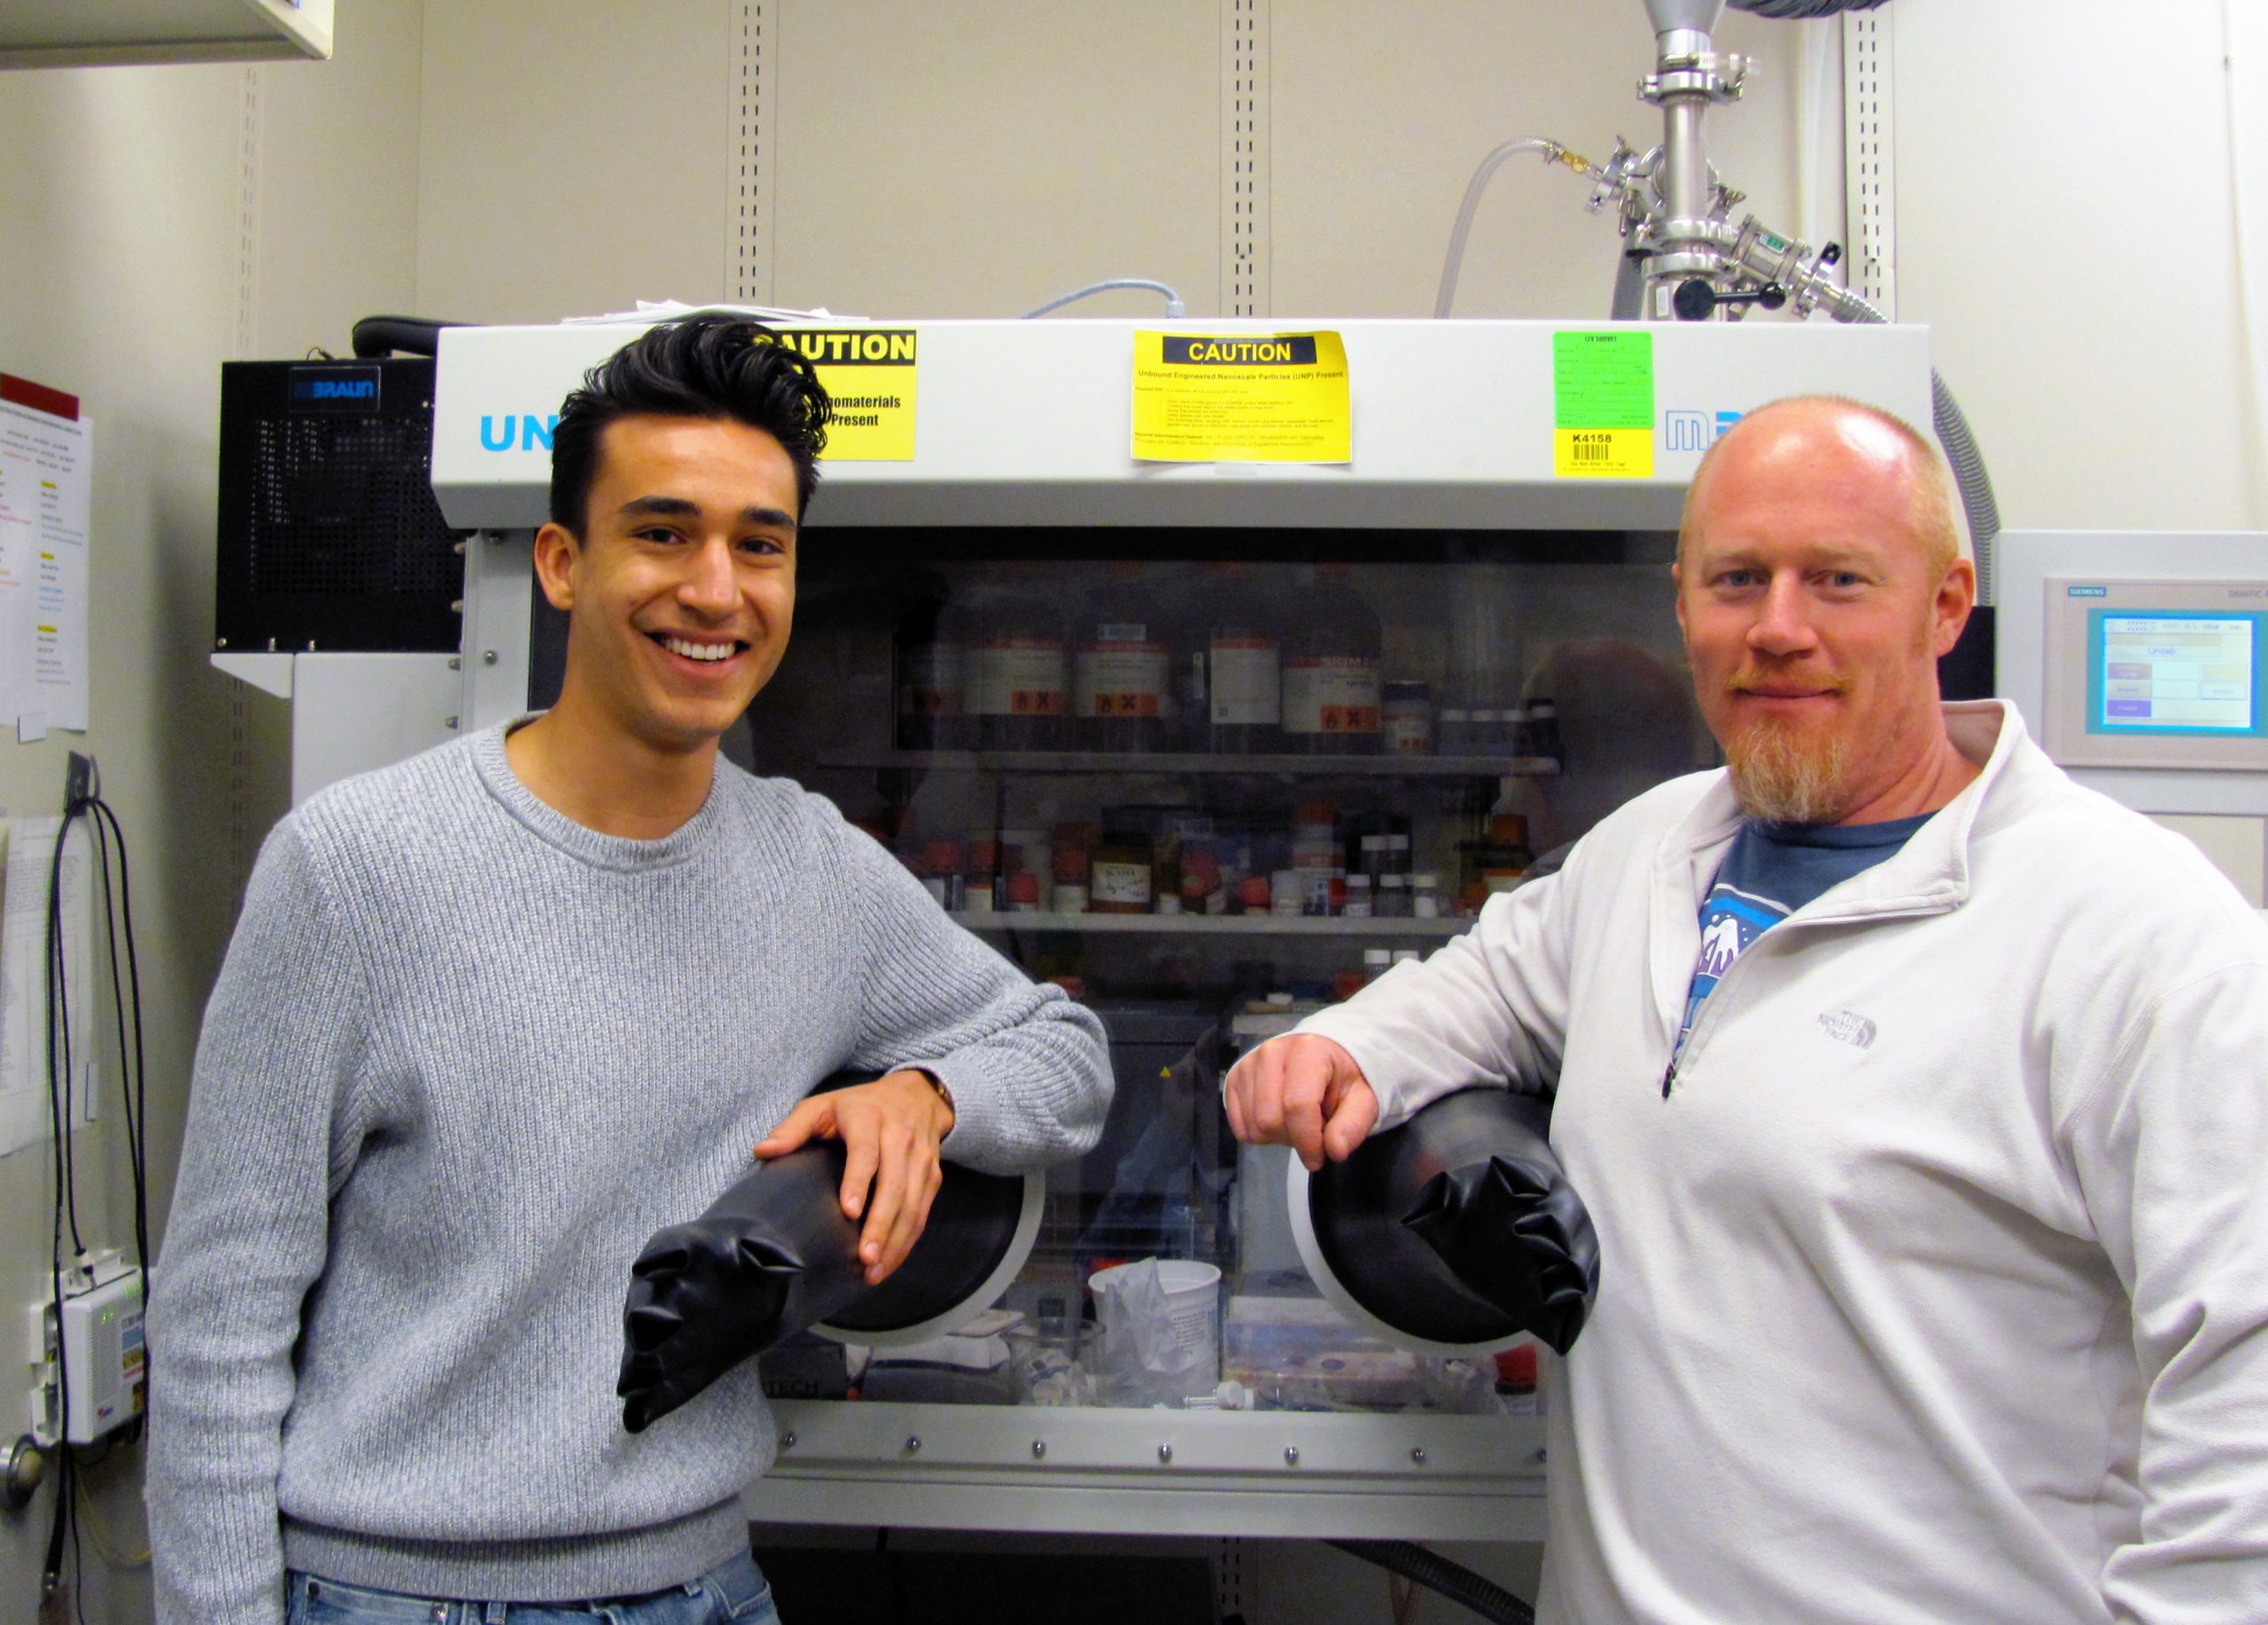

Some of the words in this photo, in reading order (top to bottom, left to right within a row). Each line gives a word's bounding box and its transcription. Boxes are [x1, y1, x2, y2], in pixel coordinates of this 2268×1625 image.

[753, 333, 915, 361] AUTION
[1188, 342, 1292, 362] CAUTION
[1138, 369, 1172, 378] Unbound
[1174, 371, 1216, 380] Engineered
[1316, 370, 1344, 379] Present
[831, 413, 879, 426] Present
[1573, 433, 1612, 443] K4158
